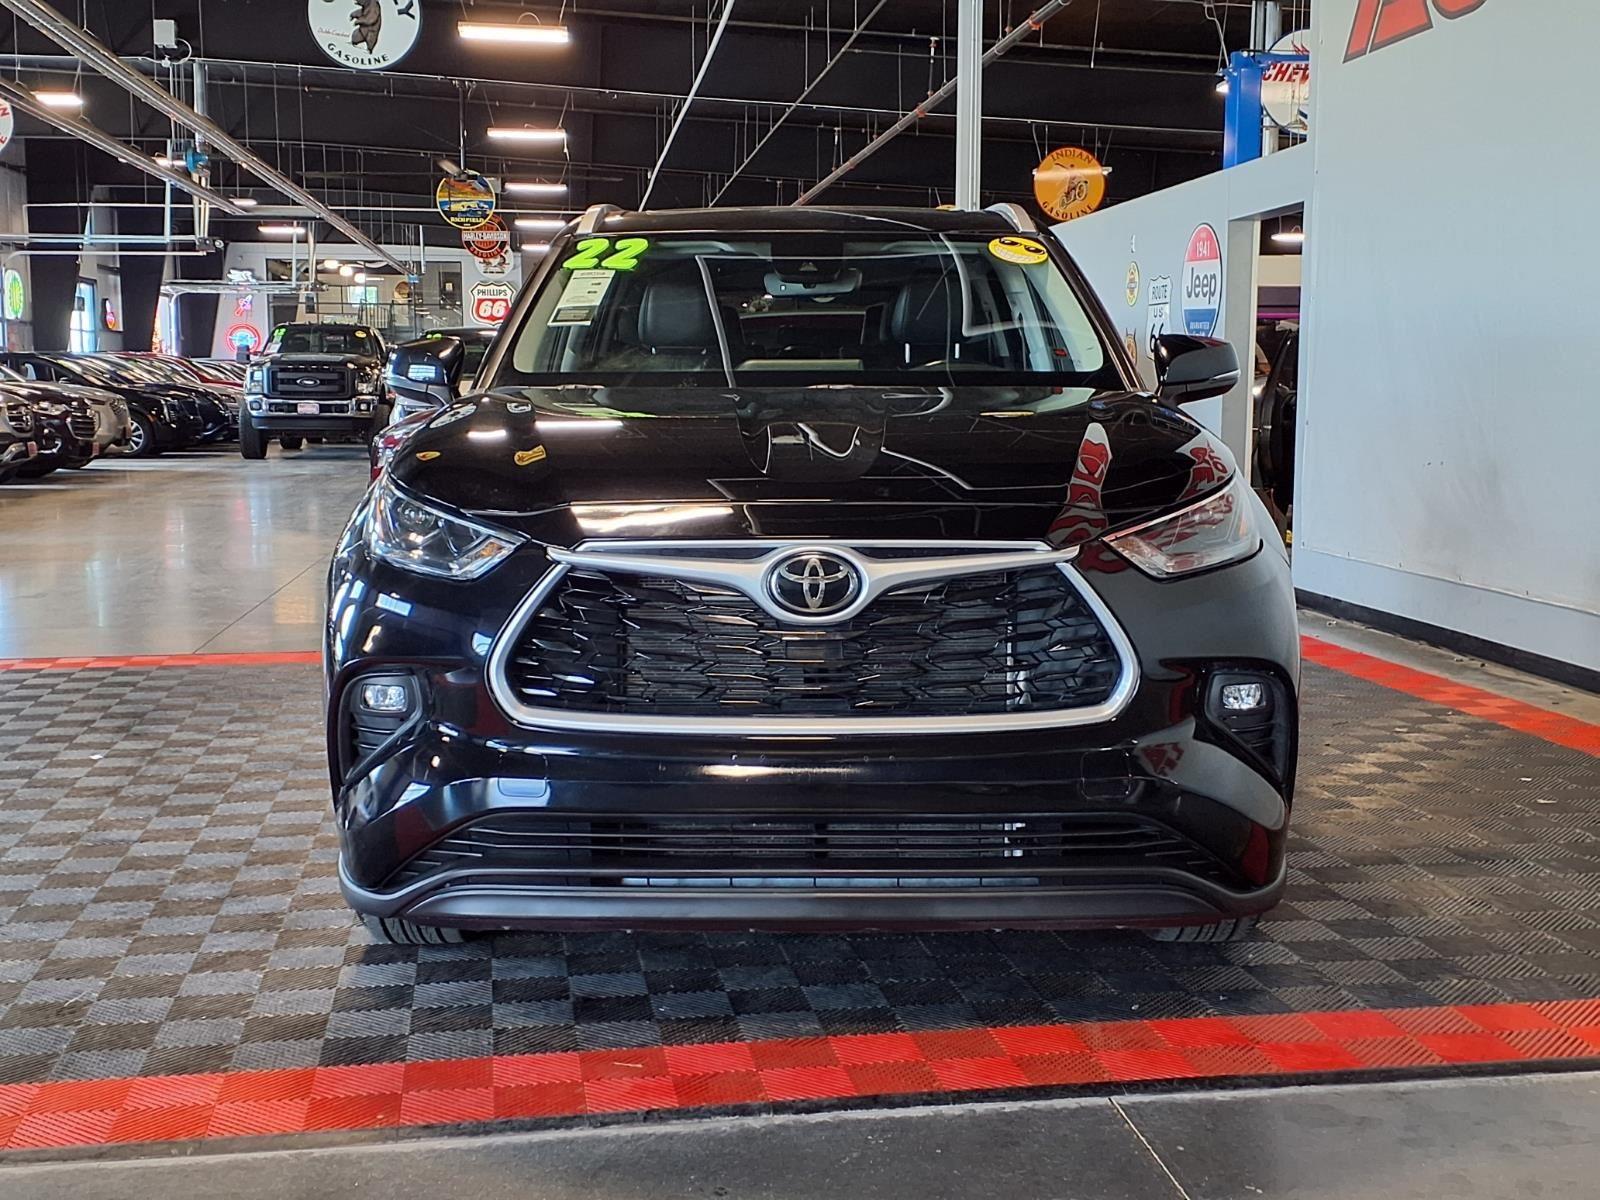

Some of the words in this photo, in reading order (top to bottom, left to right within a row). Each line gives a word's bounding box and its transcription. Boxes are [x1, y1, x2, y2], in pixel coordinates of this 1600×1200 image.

[327, 42, 390, 65] GASOLINE
[1051, 149, 1094, 165] INDIAN
[1043, 200, 1093, 219] GASOLINE
[562, 236, 649, 271] 22
[1196, 239, 1210, 257] 1941
[477, 288, 508, 297] PHILLIPS
[1152, 284, 1168, 300] ROUTE
[1186, 266, 1217, 305] Jeep
[478, 300, 507, 317] 66
